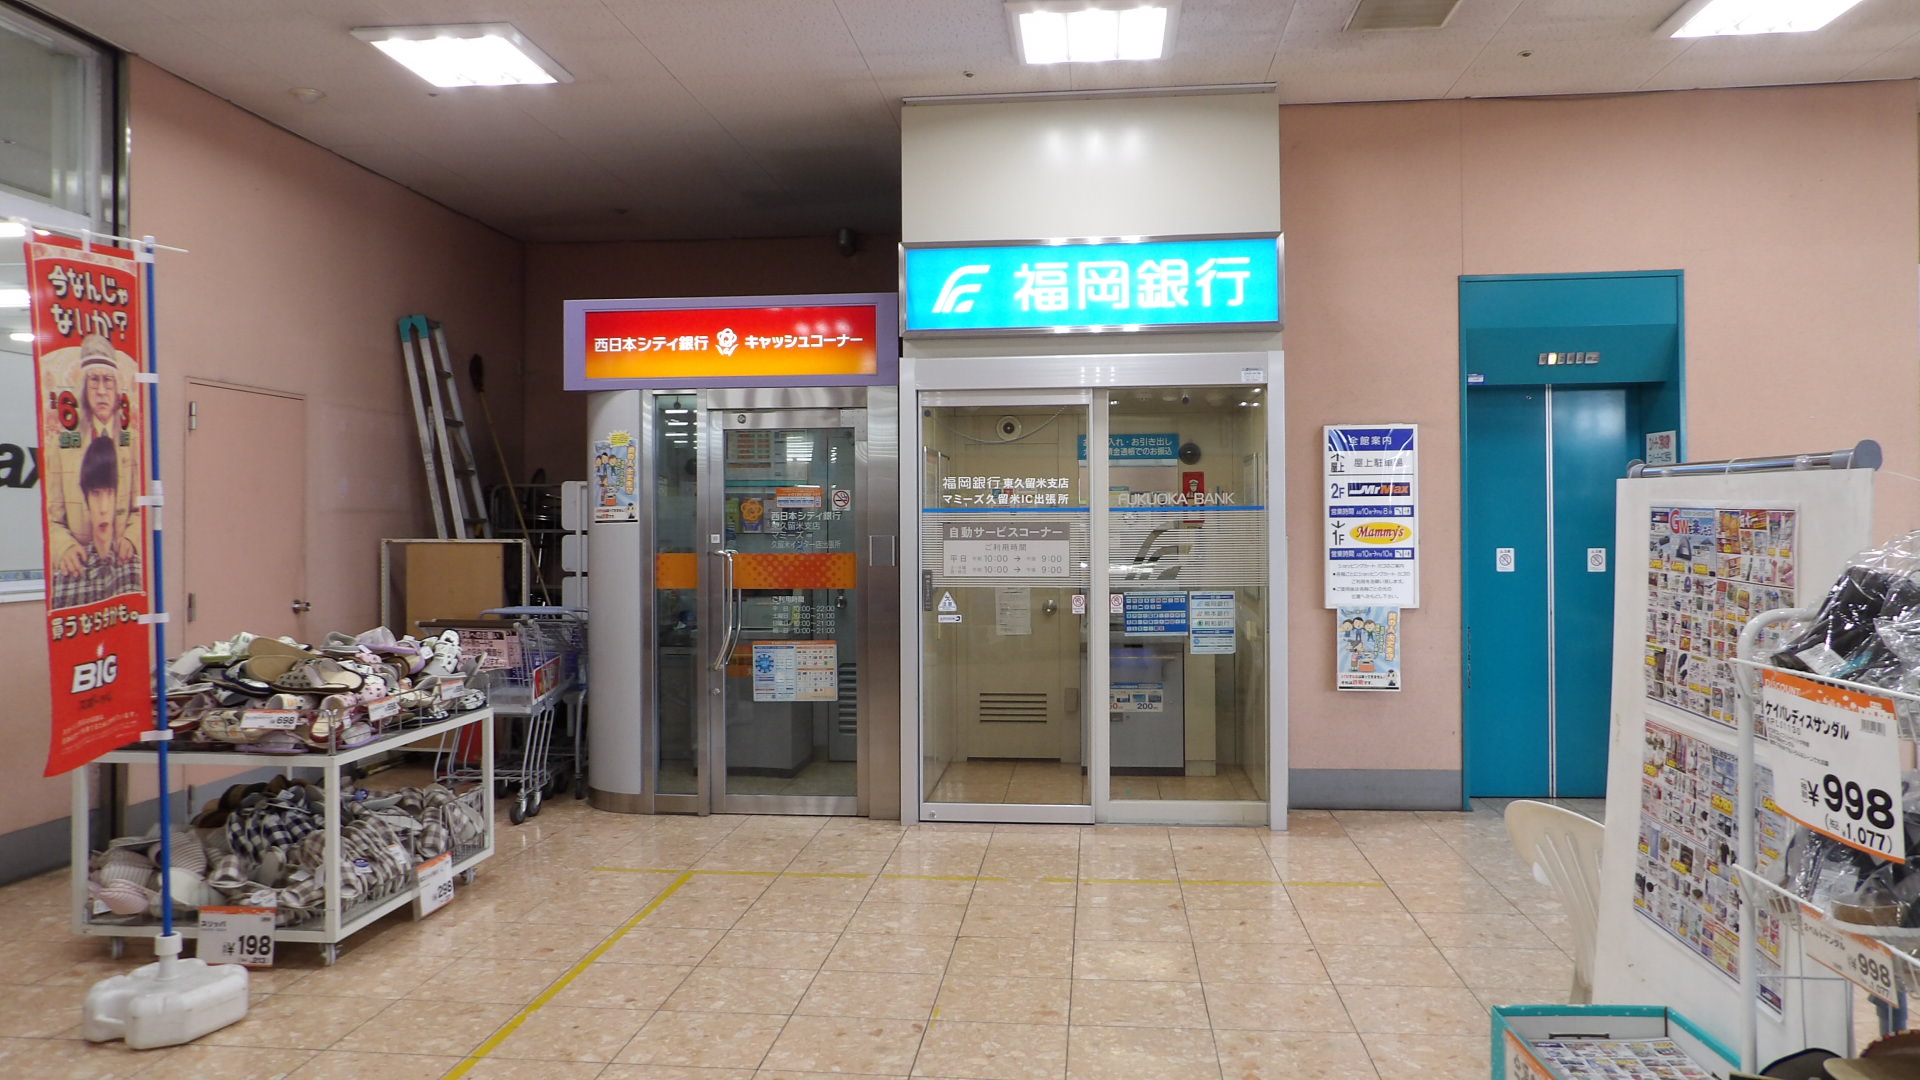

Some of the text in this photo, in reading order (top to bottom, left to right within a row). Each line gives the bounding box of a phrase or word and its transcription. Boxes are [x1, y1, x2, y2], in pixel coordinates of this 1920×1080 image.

[47, 265, 129, 305] 今なんじゃ
[1013, 256, 1251, 312] 福岡銀行
[594, 334, 863, 352] 西日本シティ銀行 キャッシュコーナー
[1349, 436, 1392, 446] 全館案内
[1331, 458, 1403, 473] 屋上 屋上駐車場
[942, 476, 1069, 489] 福岡銀行 東久留米支店
[1331, 483, 1409, 499] 2F MrMax
[942, 494, 1069, 505] マミーズ久留米IC出張所
[1118, 492, 1235, 505] FUKUOKA BANK
[771, 511, 841, 520] 西日本シティ銀行
[949, 526, 1063, 538] 自動サービスコーナー
[1332, 525, 1404, 545] 1F Mammy's
[985, 543, 1027, 551] ご利用時間
[984, 554, 1008, 563] 10:00
[1041, 554, 1062, 563] 9:00
[984, 565, 1008, 574] 10:00
[1041, 565, 1062, 574] 9:00
[71, 655, 117, 693] BIG
